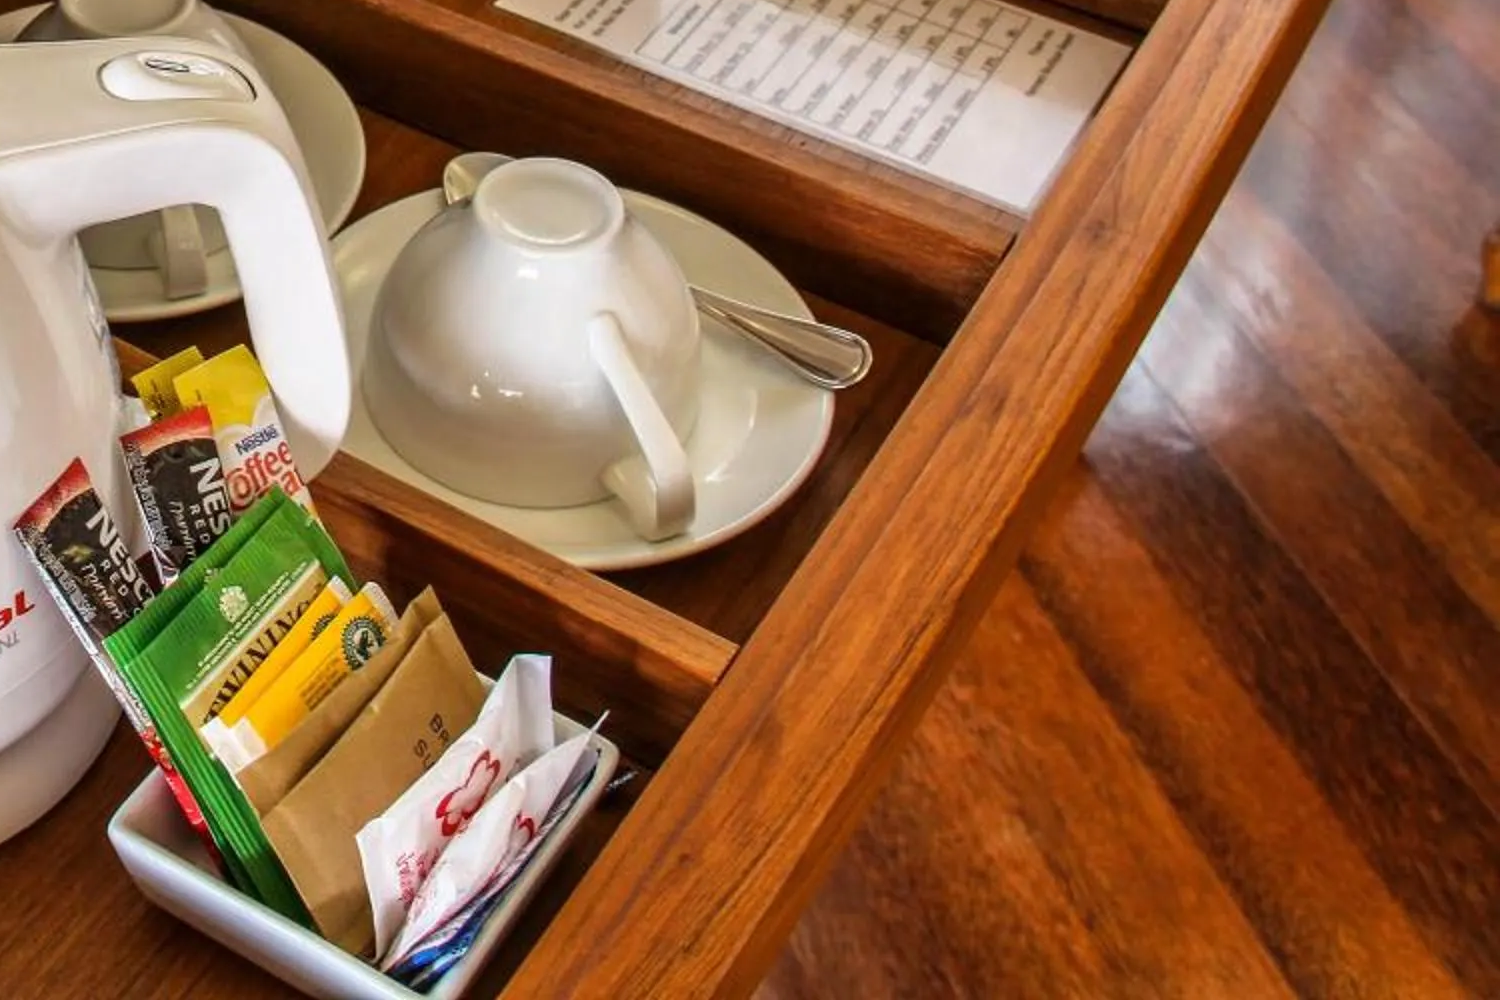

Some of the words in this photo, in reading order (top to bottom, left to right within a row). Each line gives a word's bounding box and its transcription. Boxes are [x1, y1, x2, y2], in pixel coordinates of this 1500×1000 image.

[190, 457, 233, 536] NES
[189, 504, 211, 544] RED
[100, 559, 129, 596] RED
